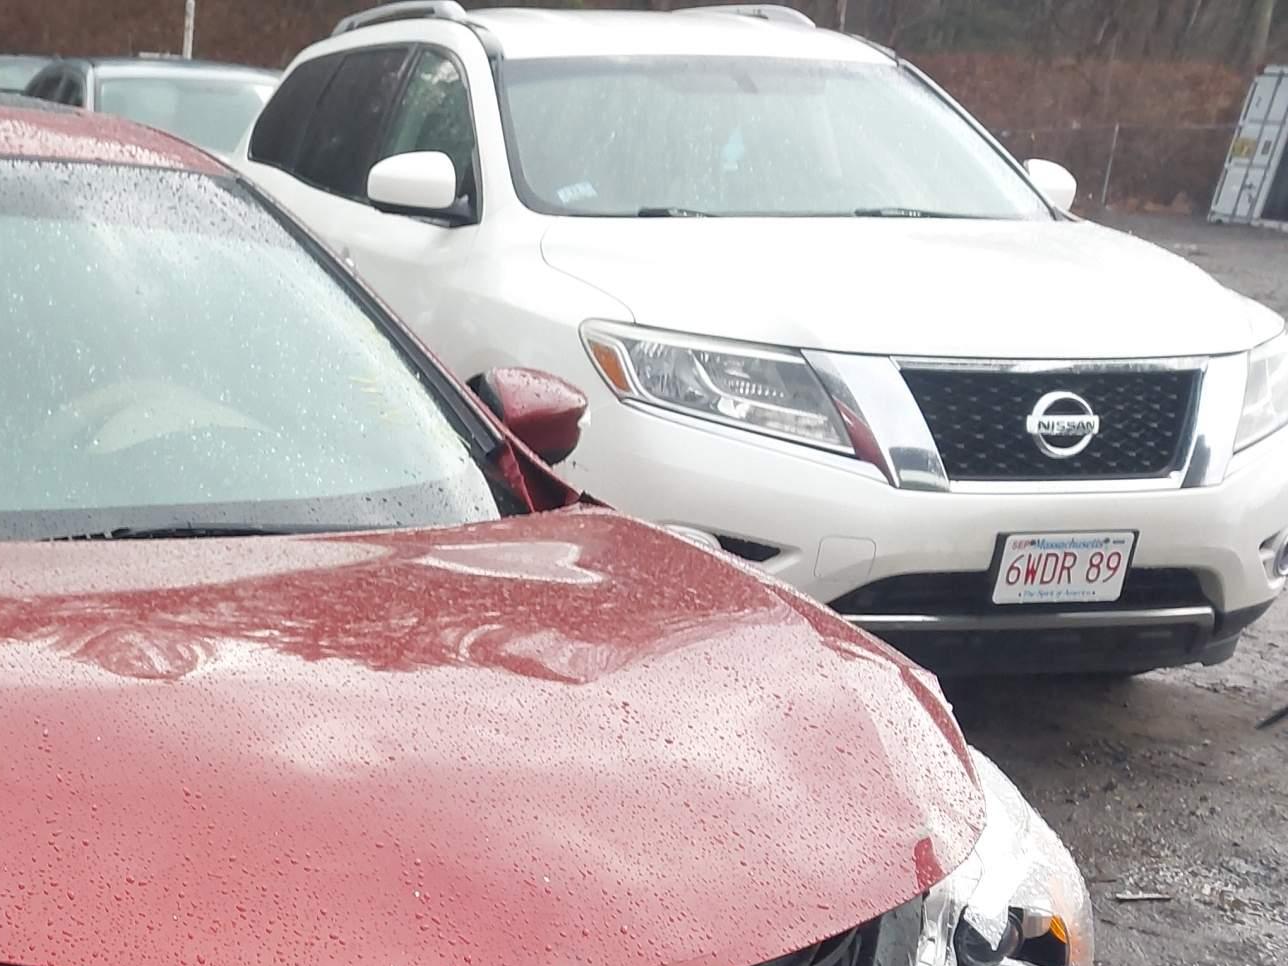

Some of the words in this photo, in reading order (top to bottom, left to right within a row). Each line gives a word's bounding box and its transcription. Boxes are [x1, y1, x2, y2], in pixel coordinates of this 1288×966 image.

[1037, 420, 1095, 432] NISSAN
[1005, 551, 1078, 586] 6WDR
[1086, 551, 1122, 584] 89
